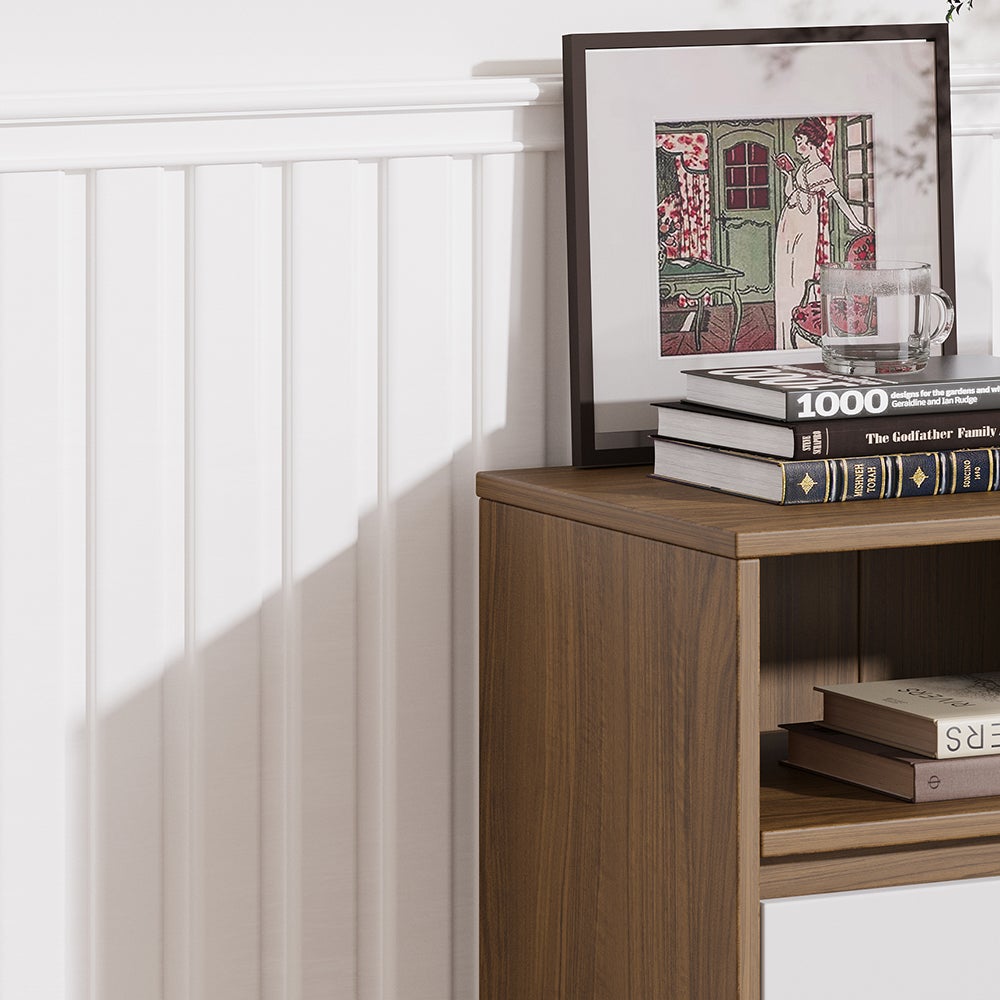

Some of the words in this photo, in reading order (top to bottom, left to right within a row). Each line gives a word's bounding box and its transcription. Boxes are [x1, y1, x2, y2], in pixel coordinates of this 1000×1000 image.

[797, 388, 889, 418] 1000
[890, 391, 919, 399] designs
[921, 389, 932, 397] for
[945, 387, 976, 397] gardens
[976, 386, 990, 394] and
[891, 399, 926, 408] Geraldine
[926, 397, 941, 406] and
[941, 397, 954, 405] Ian
[954, 395, 978, 405] Rudge
[865, 433, 890, 445] The
[892, 428, 954, 443] Godfather
[957, 425, 997, 439] Family
[853, 463, 865, 498] MISHNEH
[866, 466, 877, 494] TORAH
[962, 459, 971, 488] SONCINO
